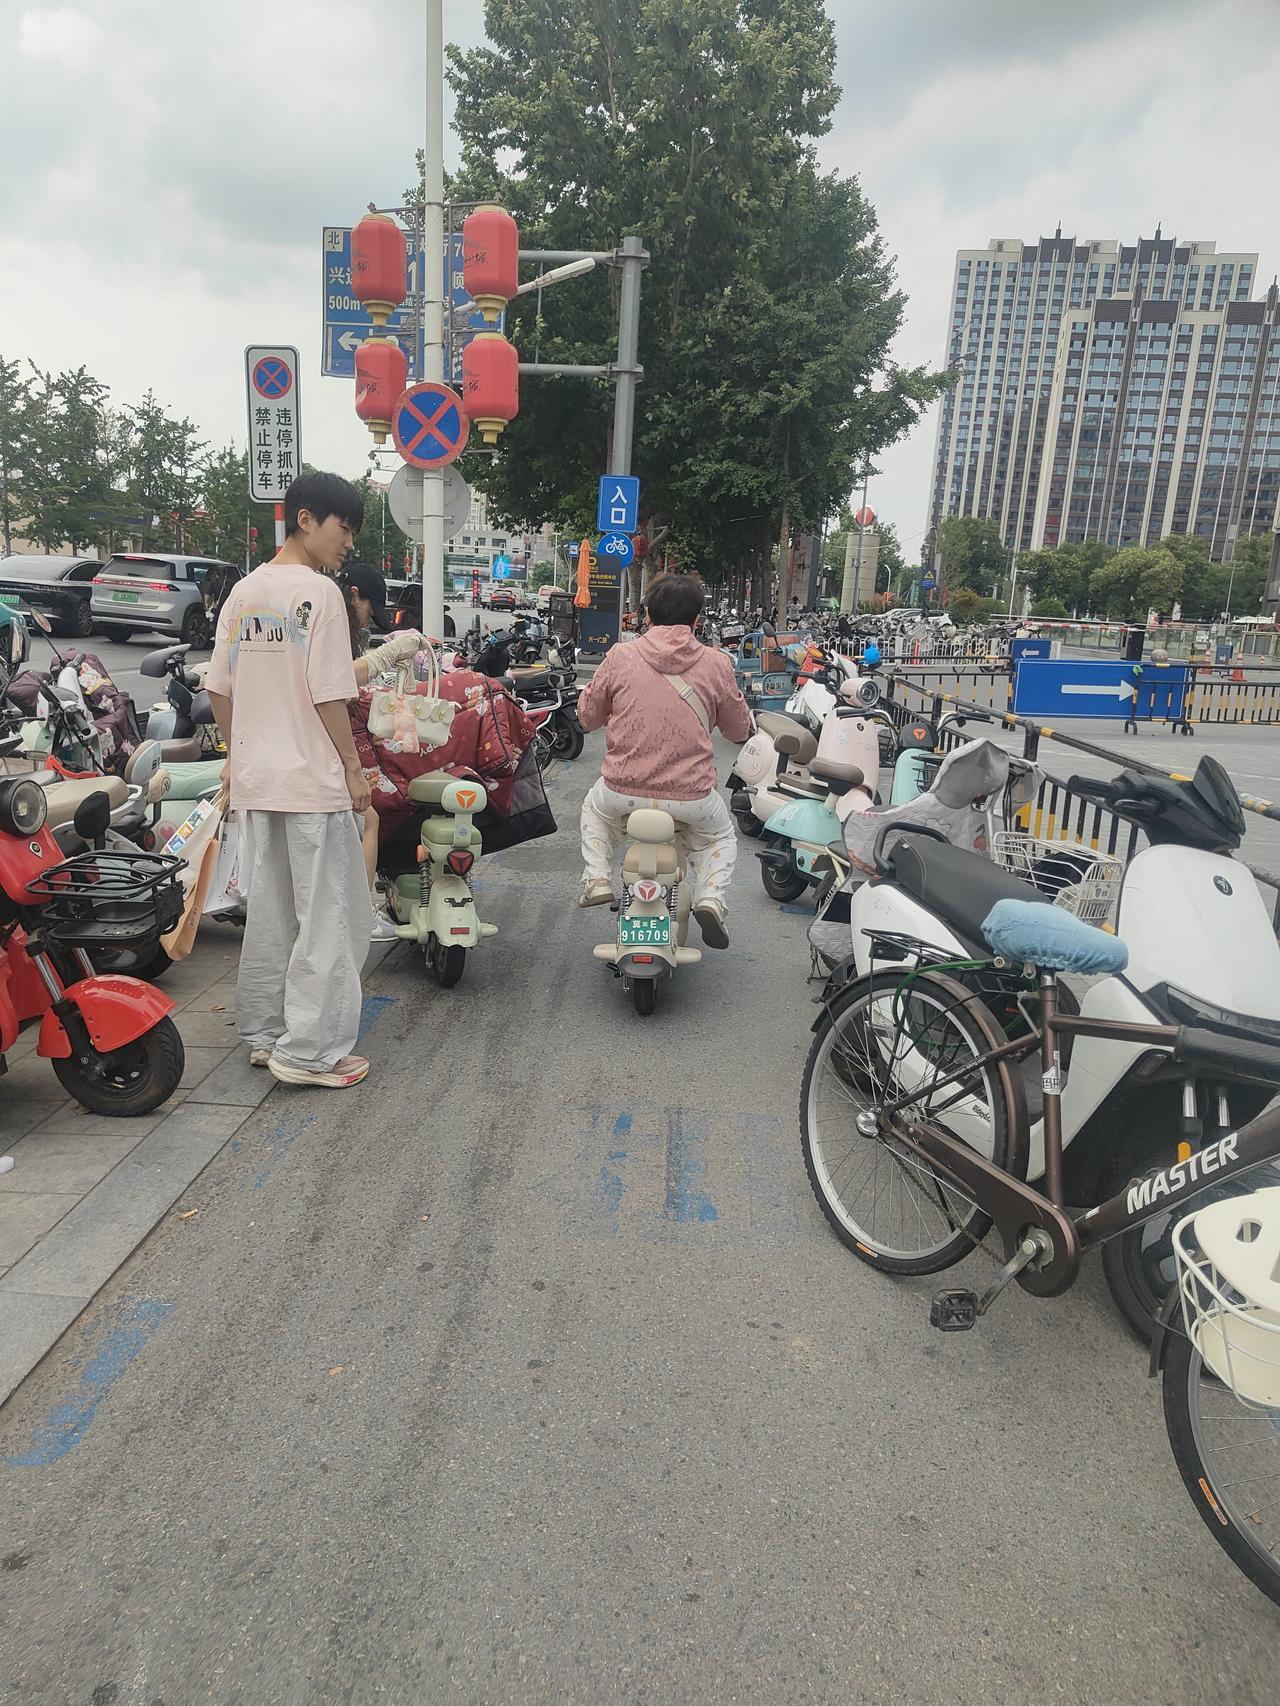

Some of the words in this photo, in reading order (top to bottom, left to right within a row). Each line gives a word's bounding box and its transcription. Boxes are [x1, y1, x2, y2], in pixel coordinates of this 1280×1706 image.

[328, 295, 361, 311] 500m
[255, 406, 274, 491] 禁止停车
[276, 407, 294, 491] 违停抓拍
[610, 485, 628, 525] 入口
[621, 930, 669, 942] 916709
[1126, 1132, 1240, 1215] MASTER
